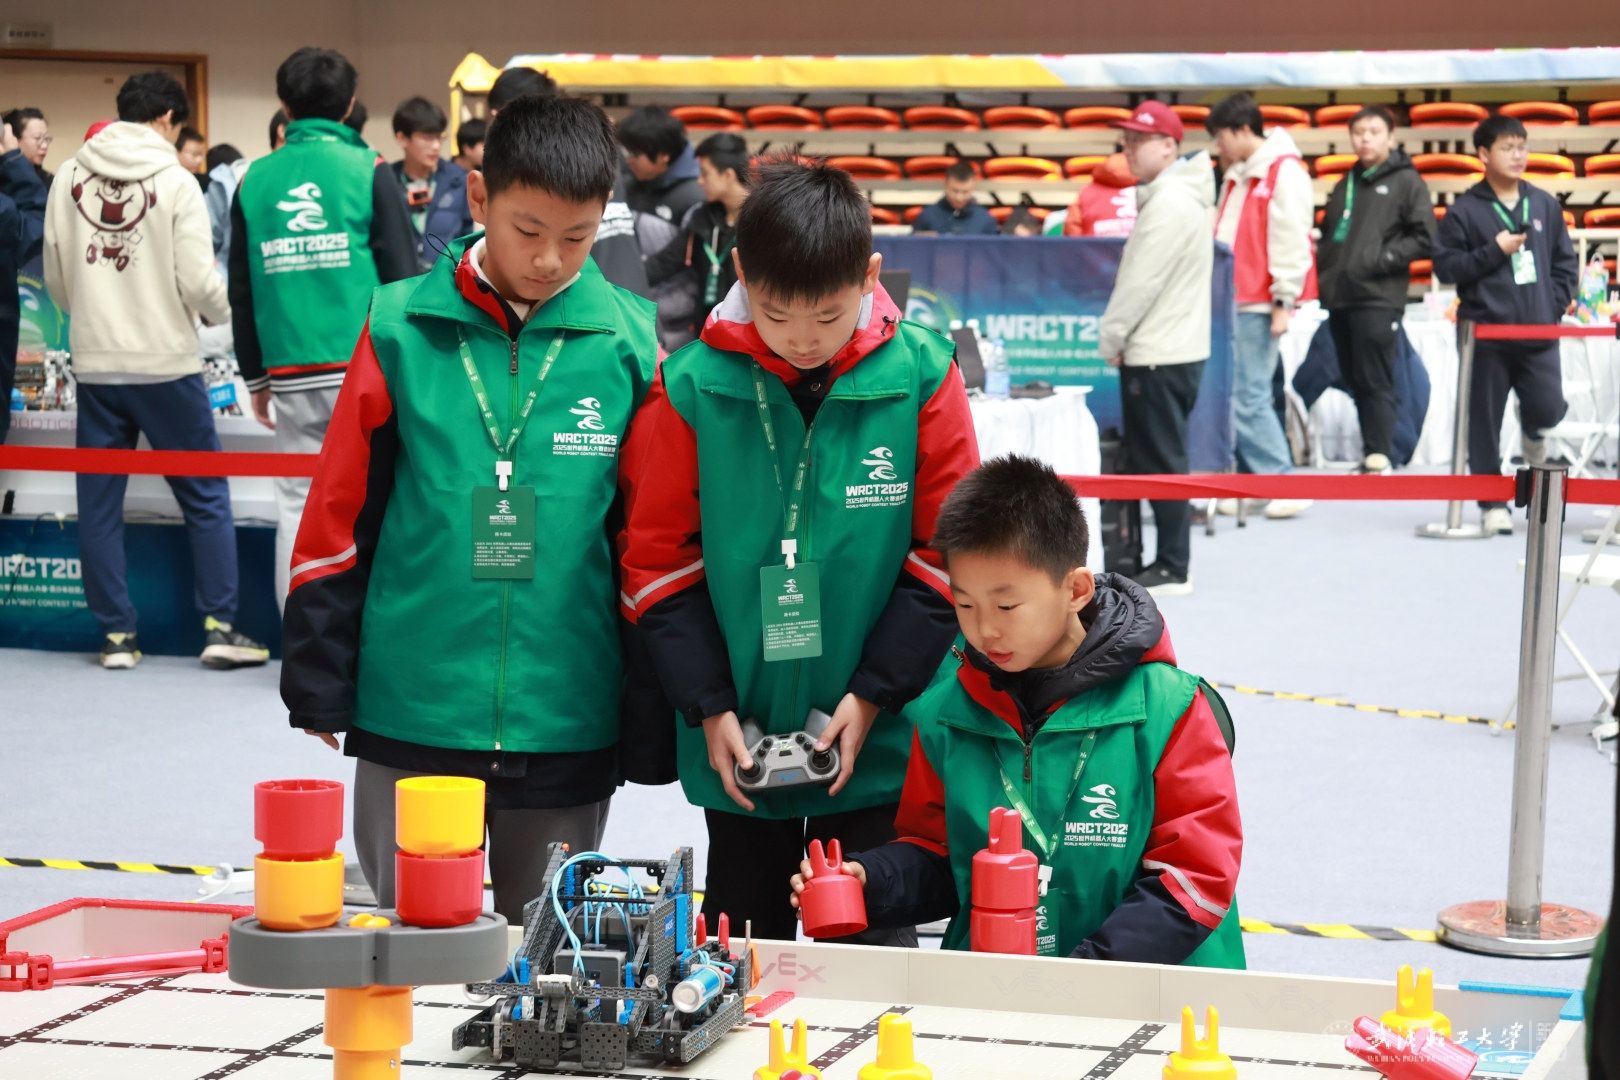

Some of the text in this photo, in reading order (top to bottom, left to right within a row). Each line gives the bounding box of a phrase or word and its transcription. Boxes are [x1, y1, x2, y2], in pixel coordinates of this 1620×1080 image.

[261, 232, 349, 258] WRCT2025
[553, 432, 618, 446] WRCT2025
[845, 482, 909, 497] WRCT2025
[1065, 822, 1129, 835] WRCT202
